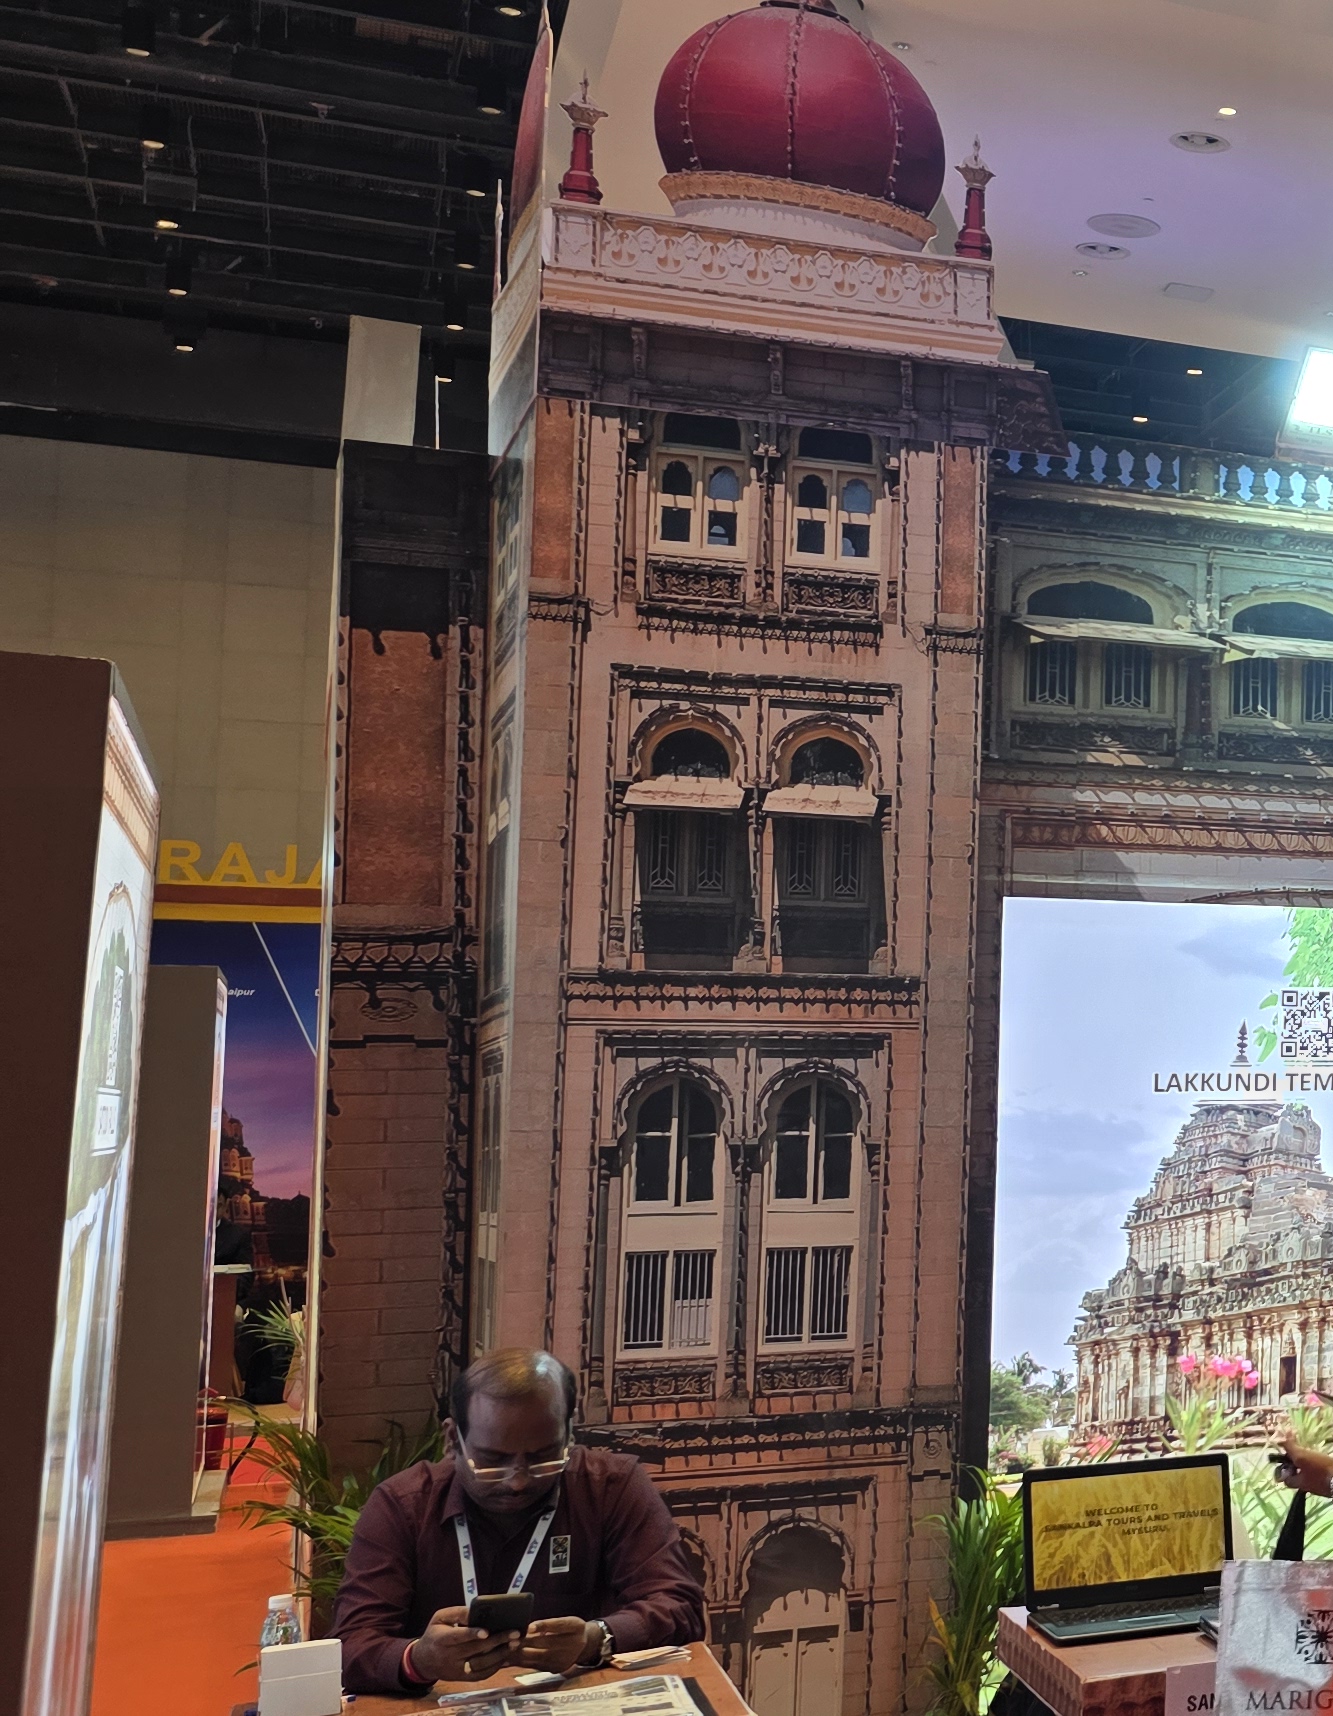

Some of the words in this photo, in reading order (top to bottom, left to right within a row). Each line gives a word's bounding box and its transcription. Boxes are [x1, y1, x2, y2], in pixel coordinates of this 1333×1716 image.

[228, 988, 256, 998] aipur
[1154, 1072, 1278, 1093] LAKKUNDI
[1084, 1504, 1141, 1517] WELCOME
[1143, 1503, 1159, 1512] TO
[1105, 1515, 1143, 1528] TOURS
[1146, 1513, 1169, 1523] AND
[1172, 1507, 1220, 1520] TRAVELS
